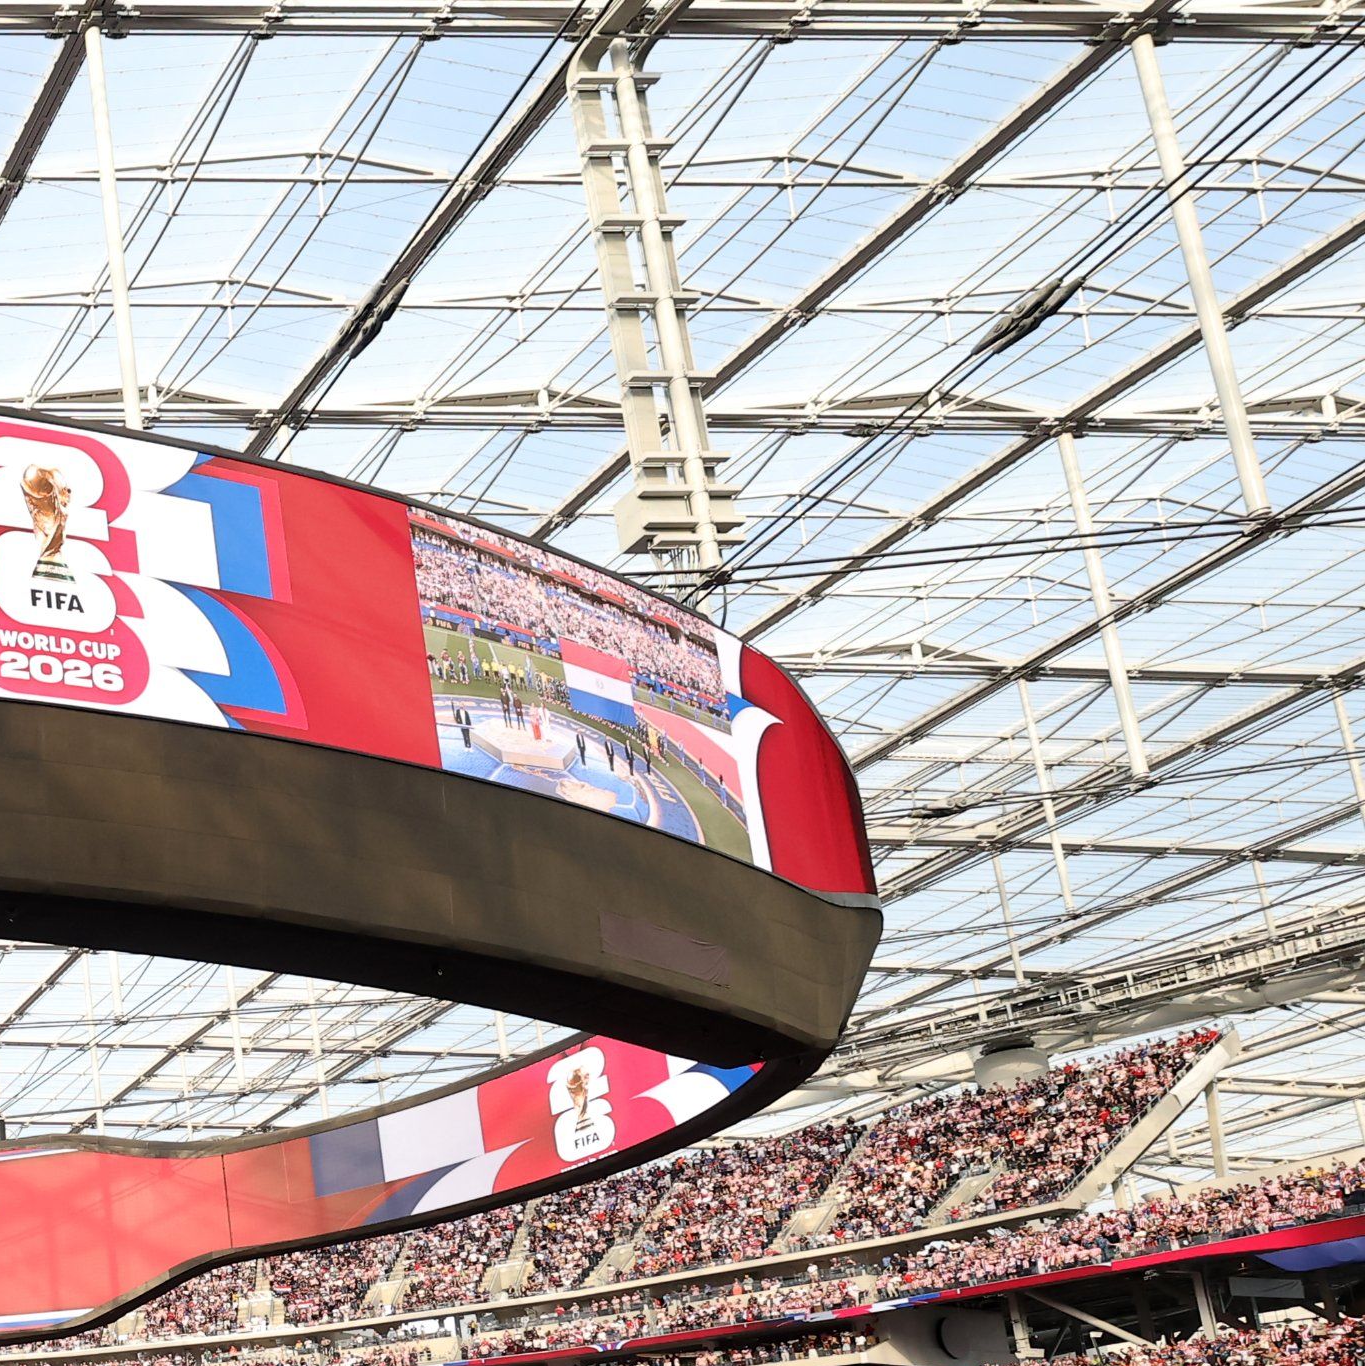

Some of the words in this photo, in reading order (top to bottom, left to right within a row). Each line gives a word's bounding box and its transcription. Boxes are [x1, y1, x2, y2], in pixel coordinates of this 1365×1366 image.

[30, 588, 85, 613] FIFA
[79, 640, 121, 660] CUP
[0, 651, 124, 692] 2026
[574, 1132, 600, 1149] FIFA
